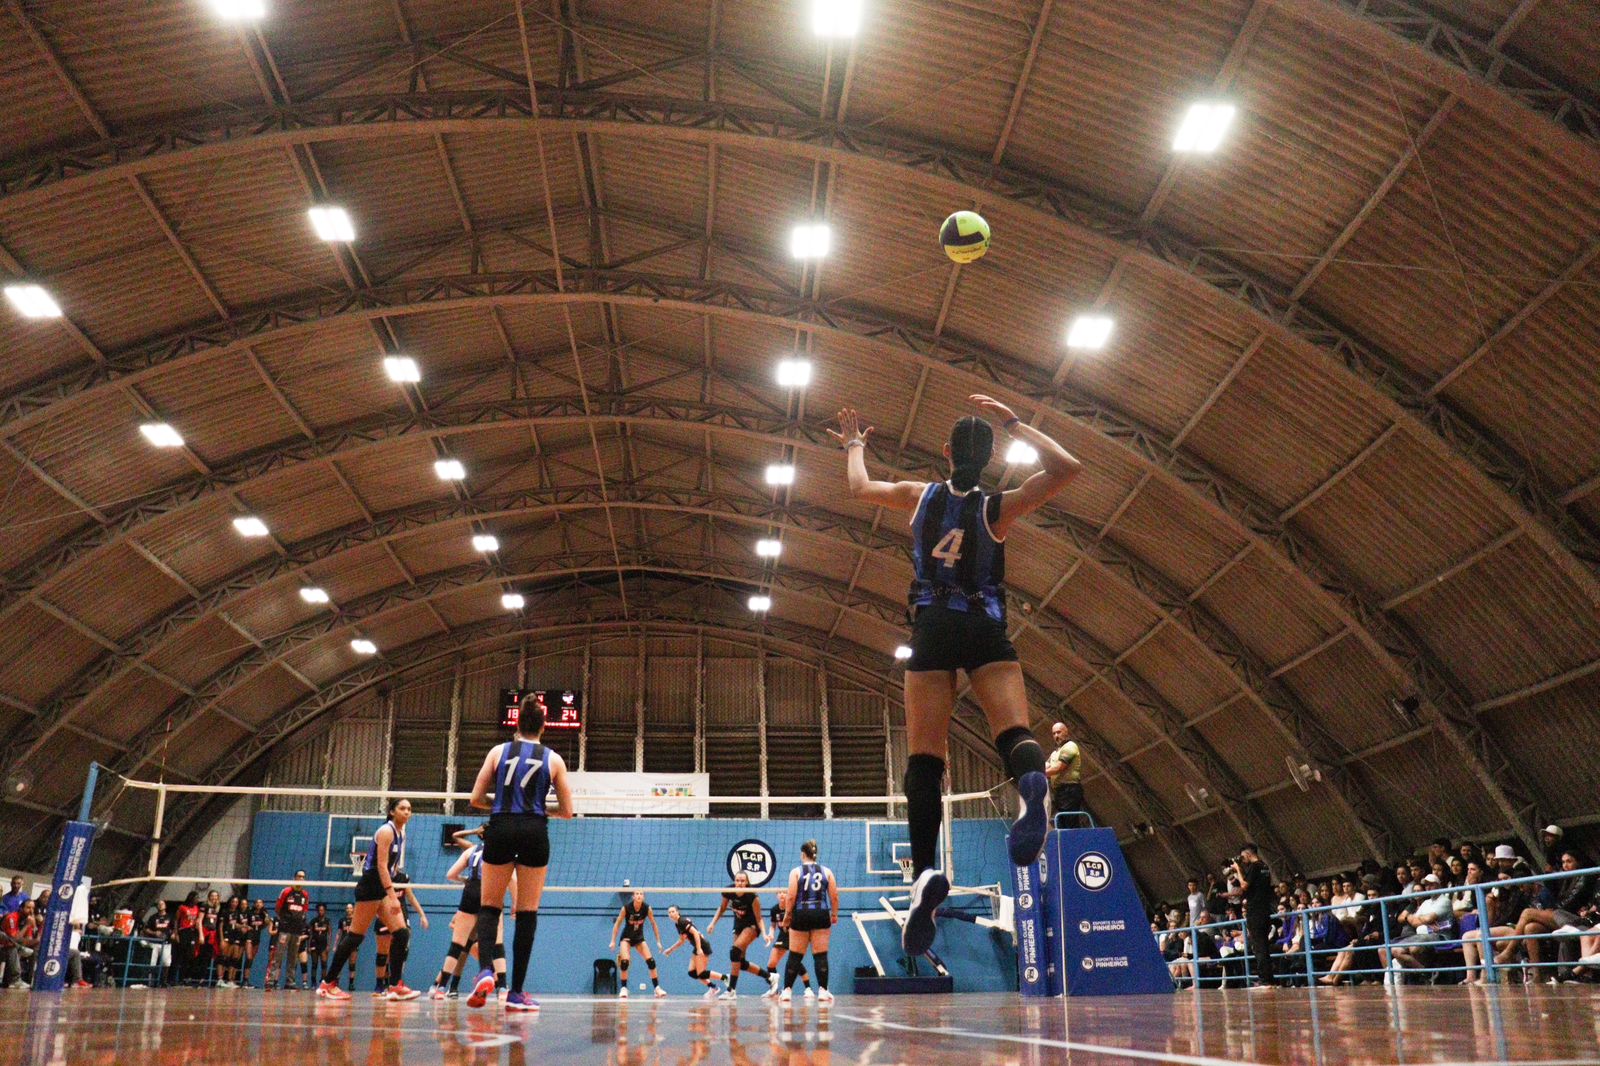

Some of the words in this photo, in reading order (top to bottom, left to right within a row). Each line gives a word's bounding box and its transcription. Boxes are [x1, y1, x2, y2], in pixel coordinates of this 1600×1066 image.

[931, 527, 965, 569] 4
[561, 709, 577, 720] 24
[503, 756, 544, 788] 17
[802, 872, 823, 891] 13
[1026, 919, 1036, 964] PINHEIROS
[1095, 960, 1128, 968] PINHEIROS
